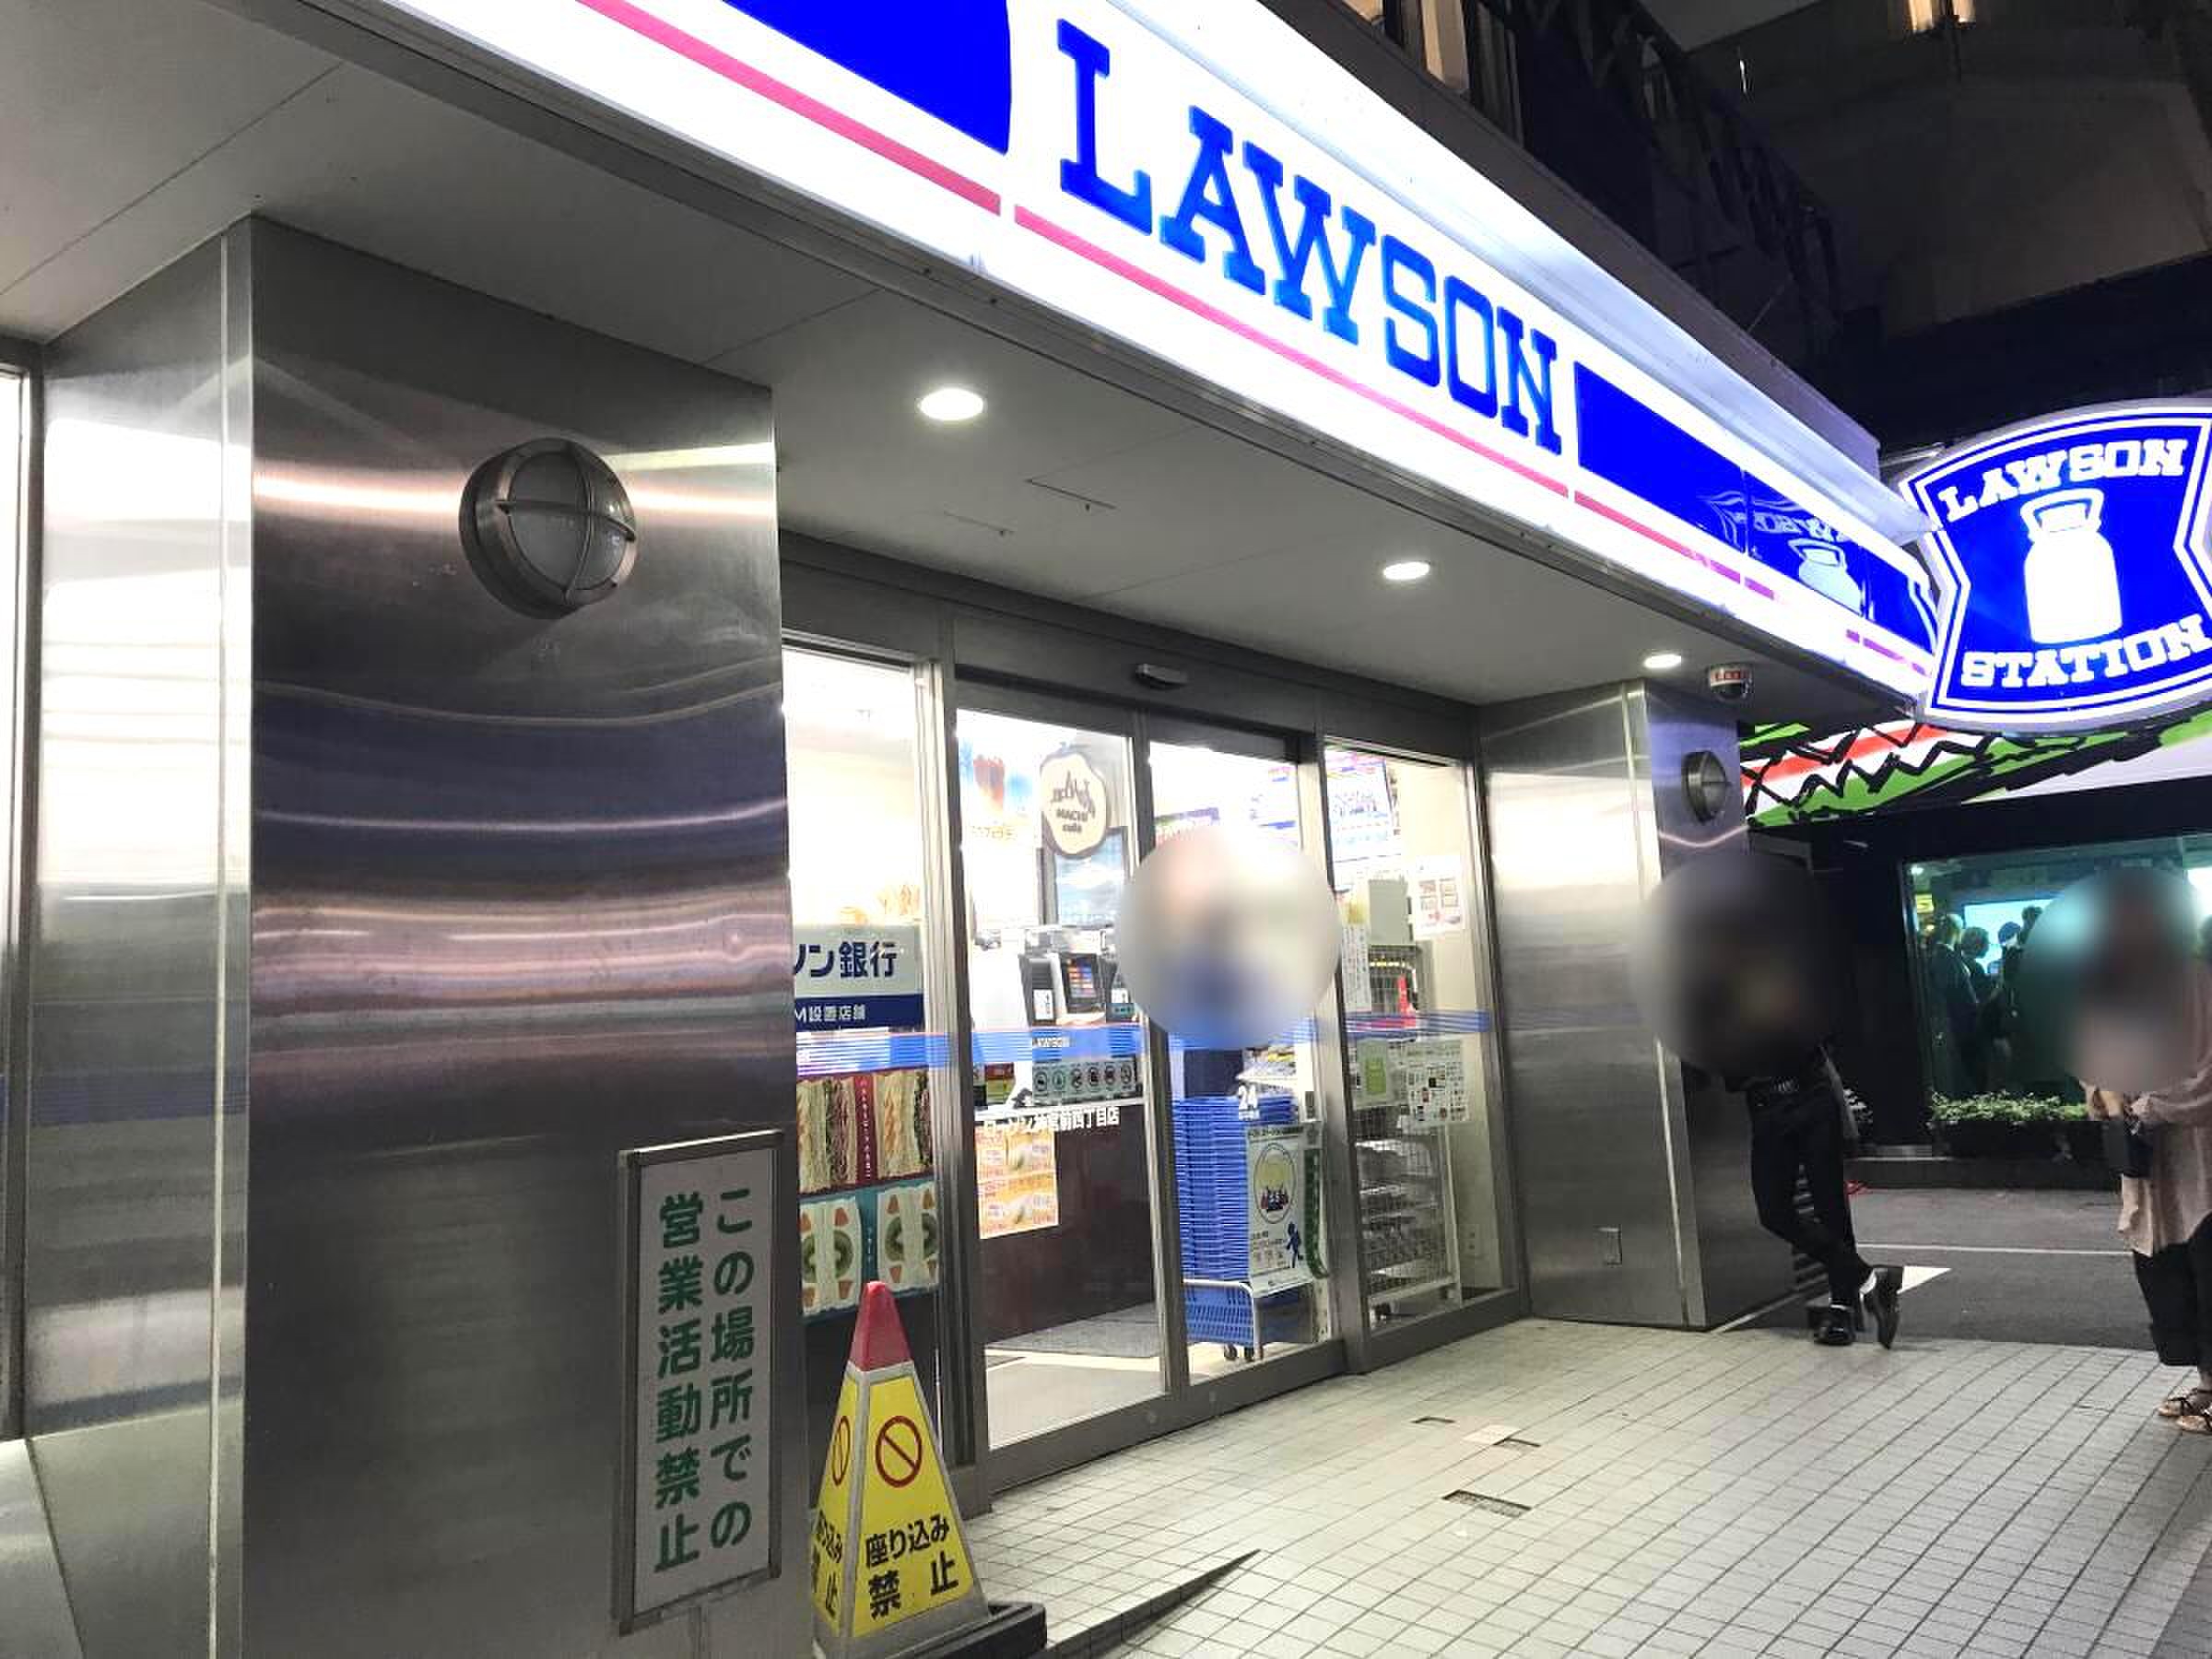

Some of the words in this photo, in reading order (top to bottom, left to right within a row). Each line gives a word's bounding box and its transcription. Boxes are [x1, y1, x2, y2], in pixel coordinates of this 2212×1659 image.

[1057, 18, 1561, 455] LAWSON
[1937, 439, 2188, 523] LAWSON
[1960, 613, 2212, 688] STATION
[653, 1193, 703, 1572] 営業活動禁止
[709, 1188, 755, 1549] この場所での
[815, 1509, 842, 1565] り込み
[865, 1512, 950, 1569] 座り込み
[867, 1550, 959, 1619] 禁止
